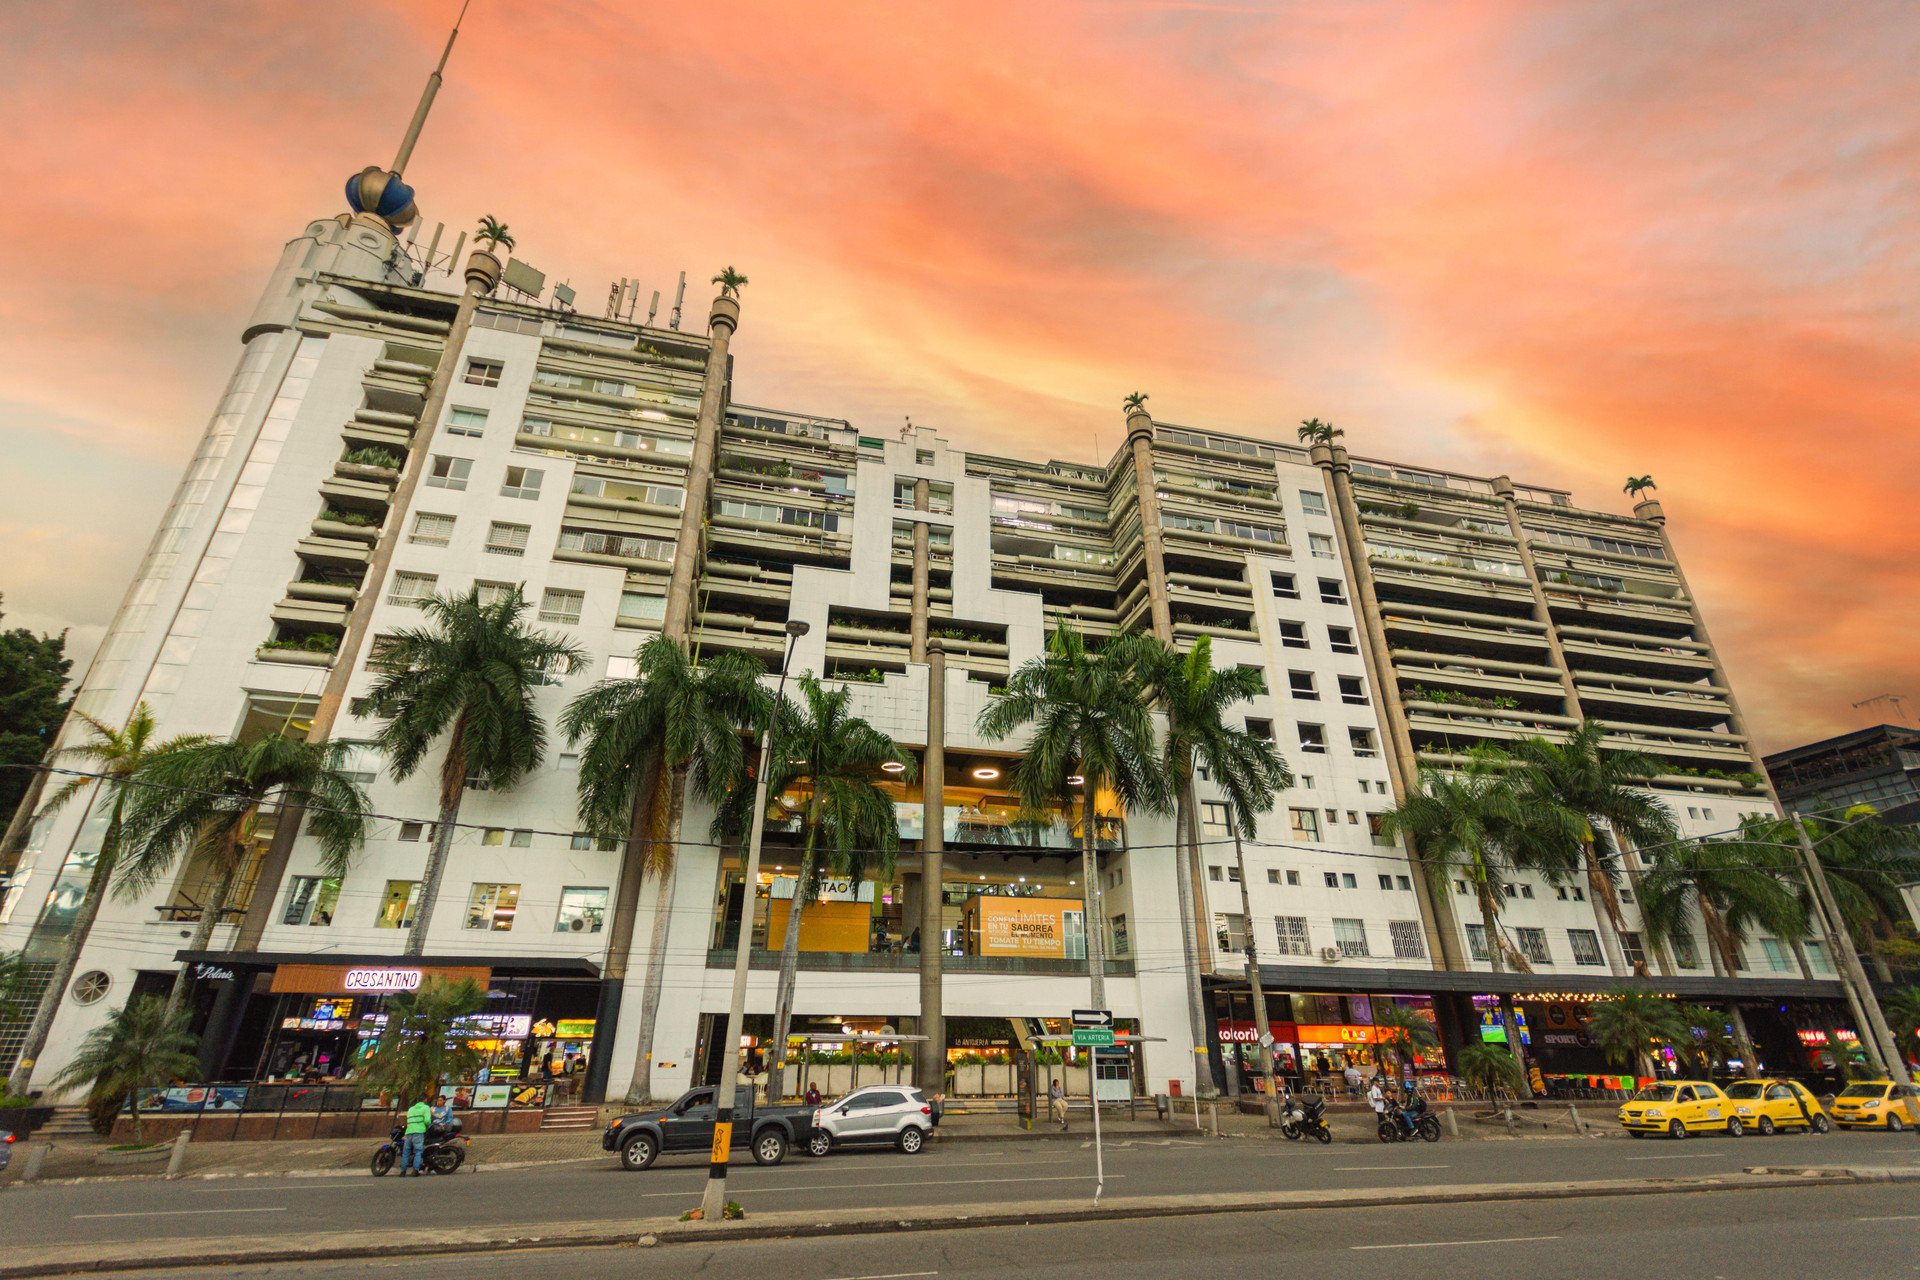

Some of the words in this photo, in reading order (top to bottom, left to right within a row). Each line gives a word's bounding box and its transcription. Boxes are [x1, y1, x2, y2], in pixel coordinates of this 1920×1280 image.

[988, 922, 998, 930] EN
[999, 922, 1008, 930] TU
[1011, 923, 1053, 933] SABOREA
[1034, 938, 1061, 946] TIEMPO
[197, 965, 234, 980] Polaris
[346, 971, 418, 988] CROSANTINO
[1218, 1027, 1259, 1041] kokorik
